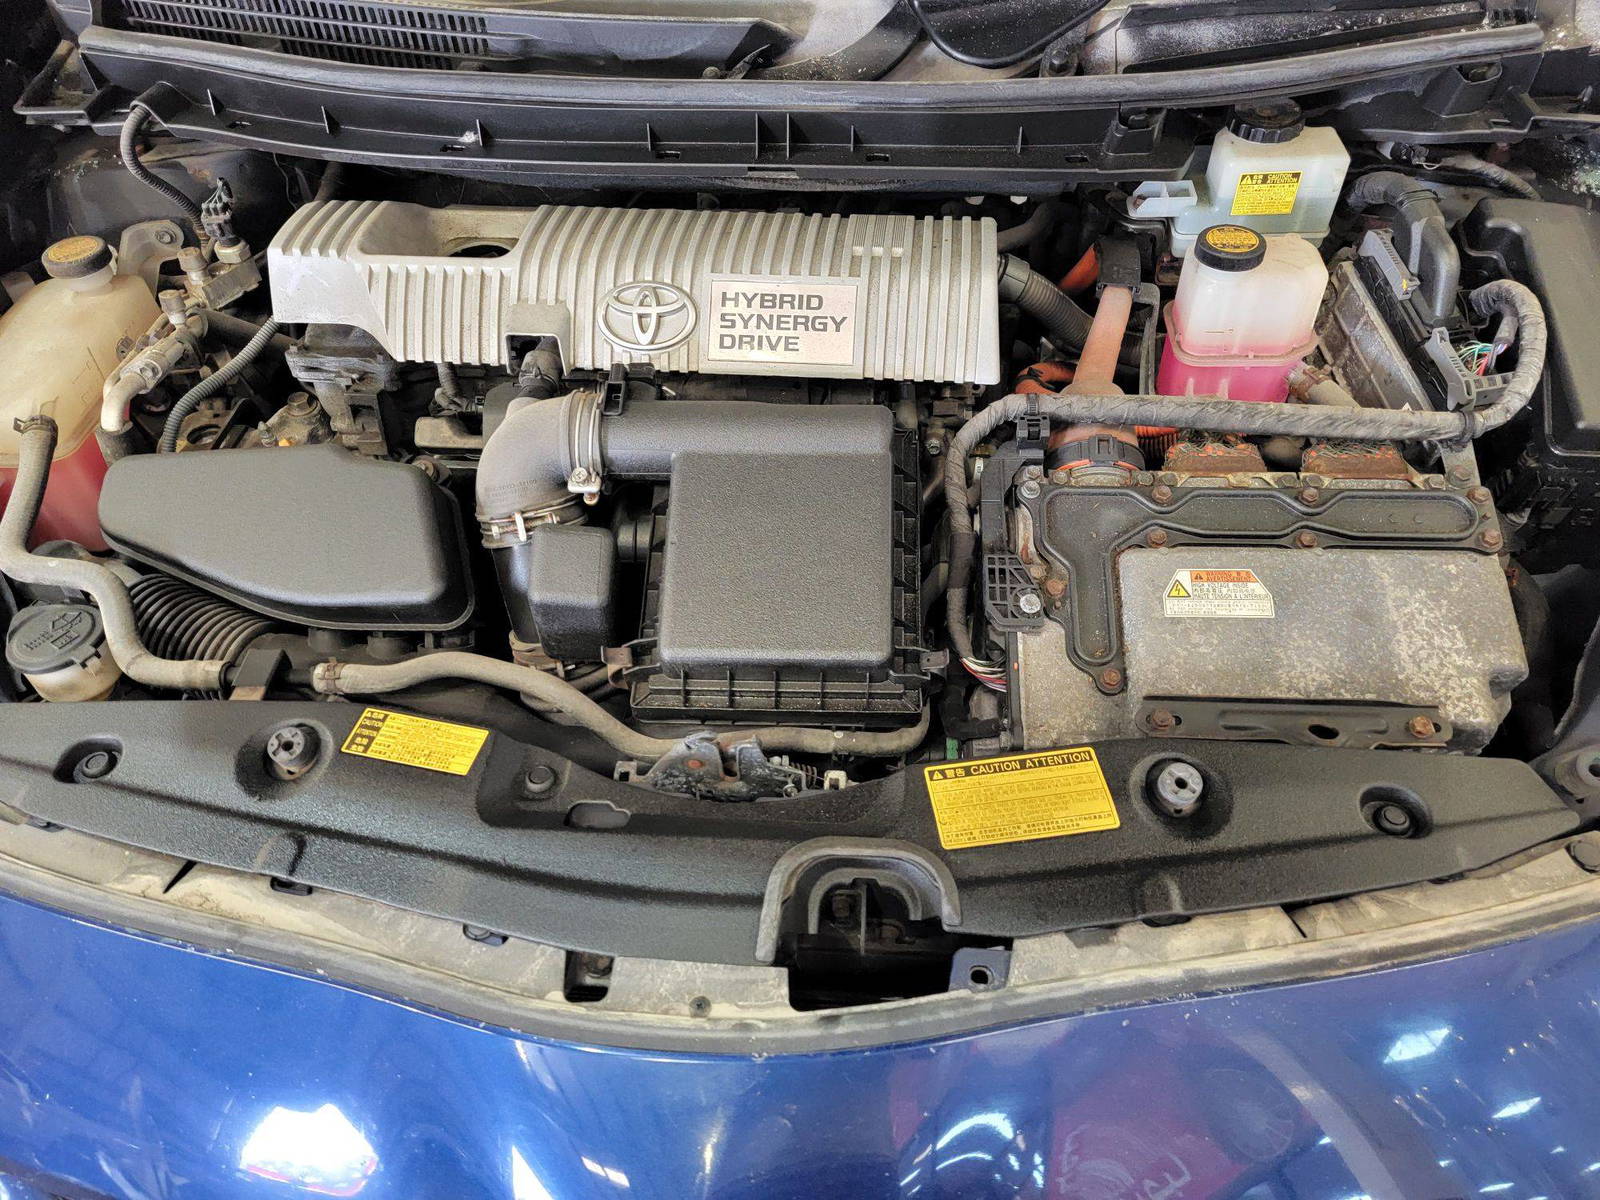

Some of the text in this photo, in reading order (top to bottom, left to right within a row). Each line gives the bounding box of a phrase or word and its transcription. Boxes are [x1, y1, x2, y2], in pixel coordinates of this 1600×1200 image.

[721, 291, 824, 311] HYBRID
[719, 312, 848, 333] SYNERGY
[719, 333, 800, 352] DRIVE
[970, 760, 1021, 776] CAUTION
[1025, 751, 1090, 769] ATTENTION
